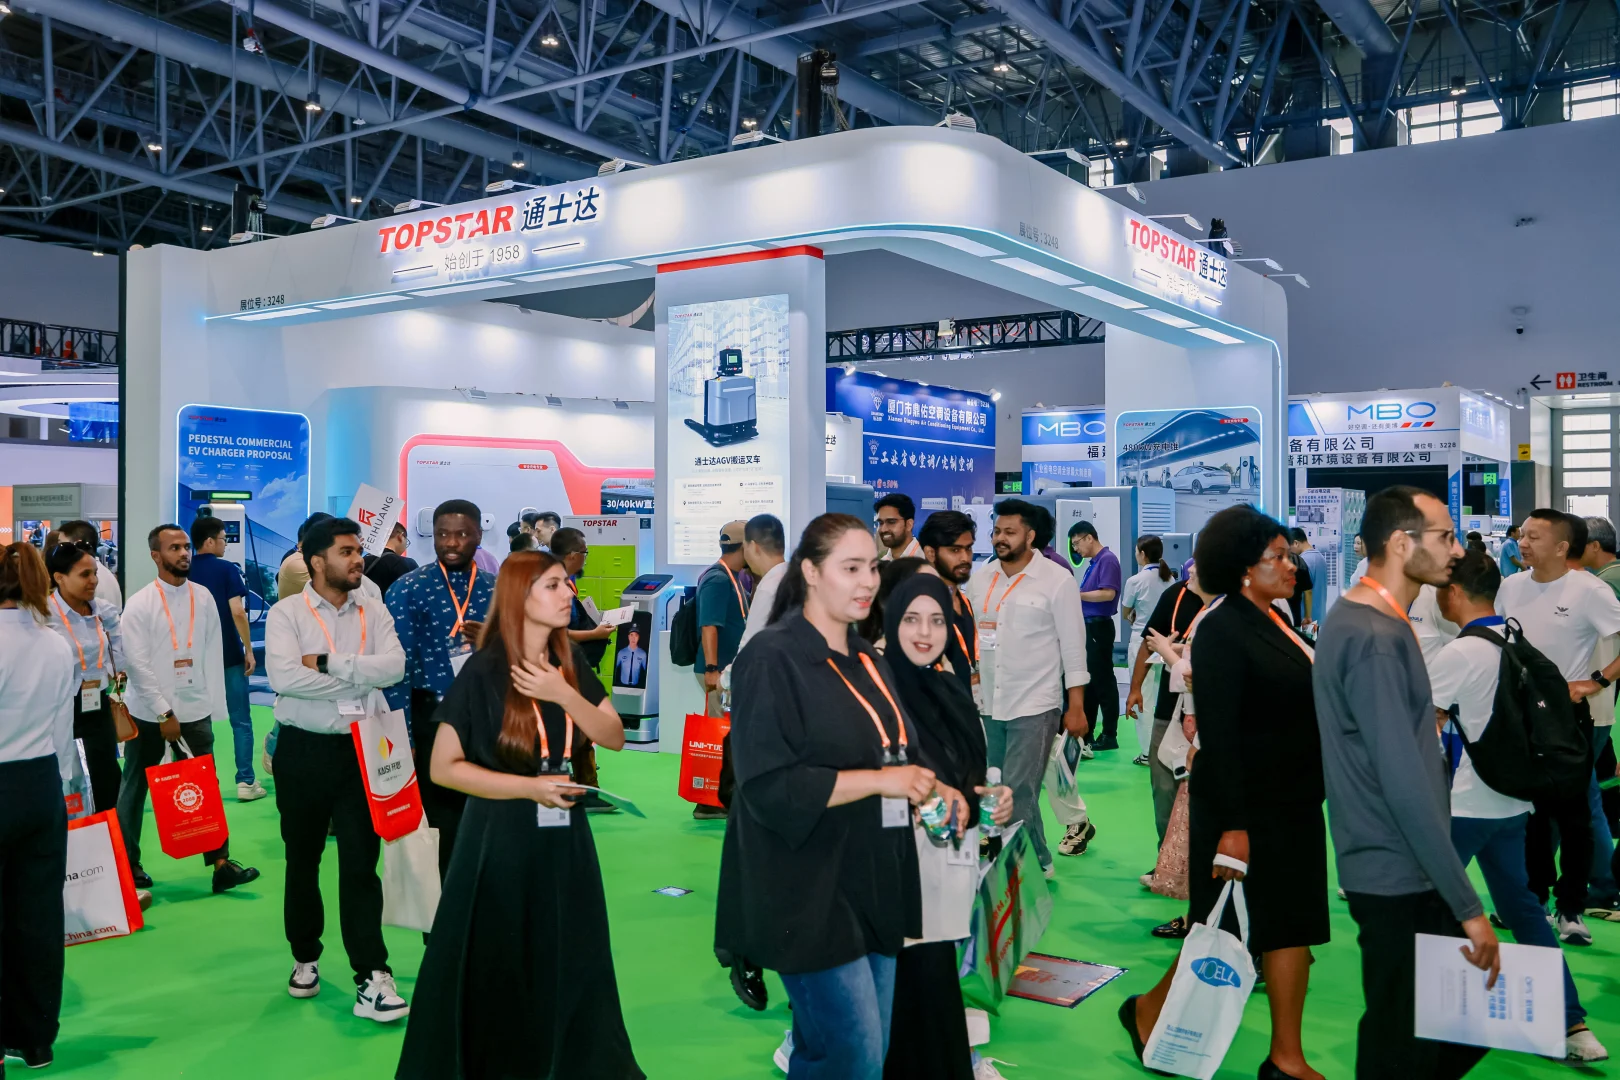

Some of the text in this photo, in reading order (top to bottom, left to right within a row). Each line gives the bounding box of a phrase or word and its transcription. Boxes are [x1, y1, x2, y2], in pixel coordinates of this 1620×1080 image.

[379, 186, 600, 253] TOPSTAR 通士达
[444, 244, 520, 271] 始创于 1958
[1130, 218, 1227, 288] TOPSTAR 通士达
[1577, 380, 1613, 388] RESTROOM
[1578, 372, 1607, 381] 卫生间
[887, 399, 987, 427] 厦门市鼎佑空调设备有限公司
[1347, 401, 1437, 421] MBO
[887, 415, 903, 423] Xiamen
[927, 421, 951, 431] Conditioning
[951, 424, 971, 433] Equipment
[1038, 420, 1105, 437] MBO
[188, 433, 293, 449] PEDESTAL COMMERCIAL
[188, 446, 293, 461] EV CHARGER PROPOSAL
[694, 455, 761, 466] 通士达AGV搬运叉车
[363, 496, 394, 551] FEIHUANG
[582, 519, 618, 527] TOPSTAR
